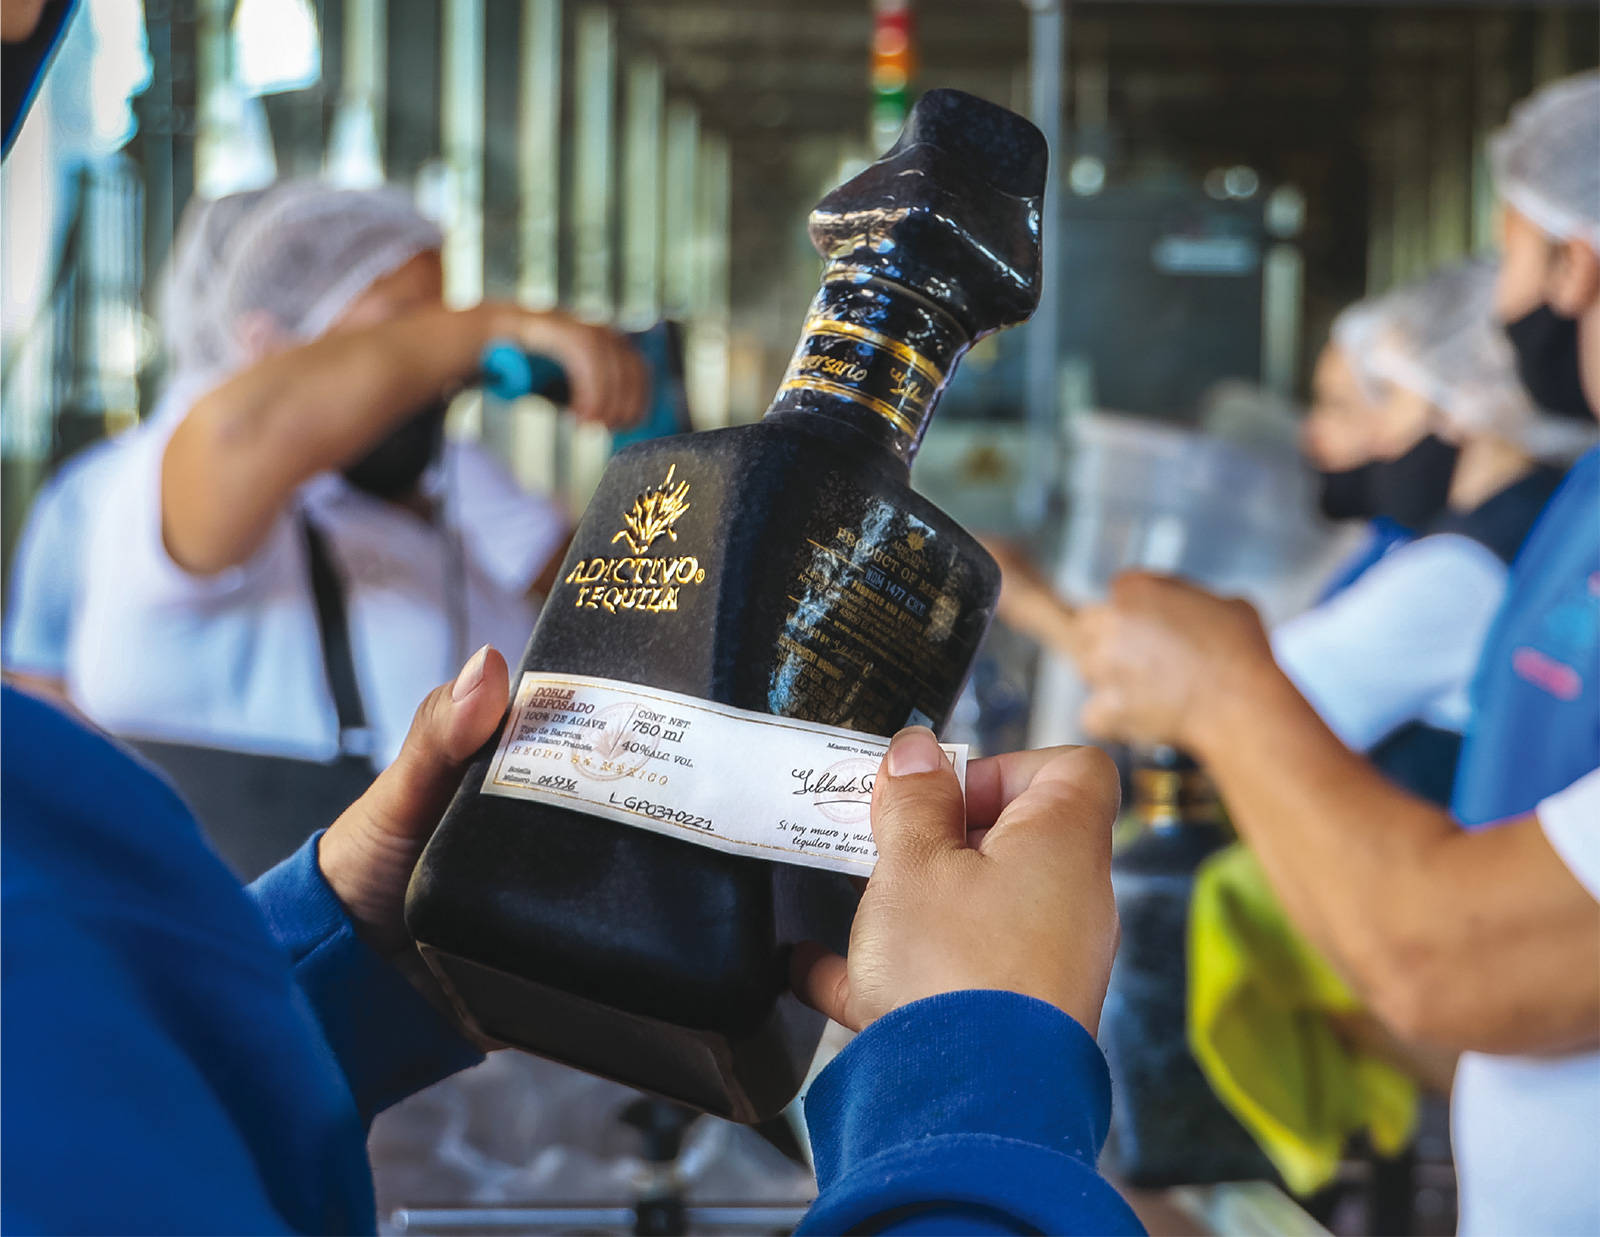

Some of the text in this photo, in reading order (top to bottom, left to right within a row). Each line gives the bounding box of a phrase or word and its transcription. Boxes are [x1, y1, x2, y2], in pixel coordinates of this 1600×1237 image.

[836, 527, 899, 572] PRODUCT
[575, 585, 680, 614] TEQUILA
[534, 687, 576, 700] DOBLE
[528, 697, 595, 714] REPOSADO
[552, 714, 568, 723] DE
[568, 716, 607, 730] AGAVE
[631, 720, 686, 744] 750 ml
[790, 822, 808, 837] hoy
[810, 826, 840, 838] muero
[842, 832, 850, 843] y
[792, 836, 831, 851] tequilero
